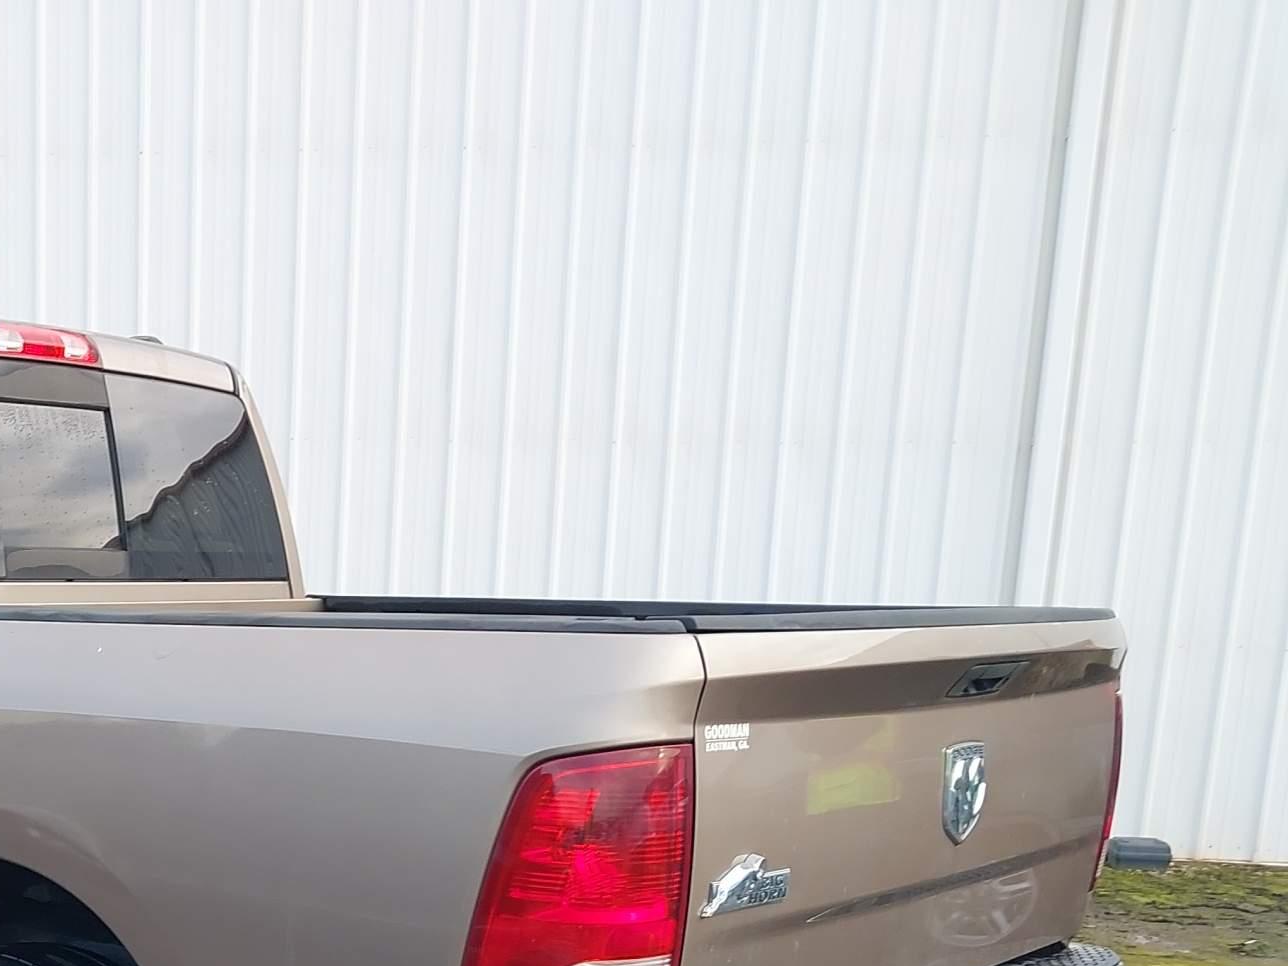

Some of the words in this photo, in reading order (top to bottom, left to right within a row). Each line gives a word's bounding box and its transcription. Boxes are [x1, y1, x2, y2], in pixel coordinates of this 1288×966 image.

[704, 723, 750, 739] GOODMAN
[761, 874, 785, 890] BIG
[748, 887, 787, 904] HORN
